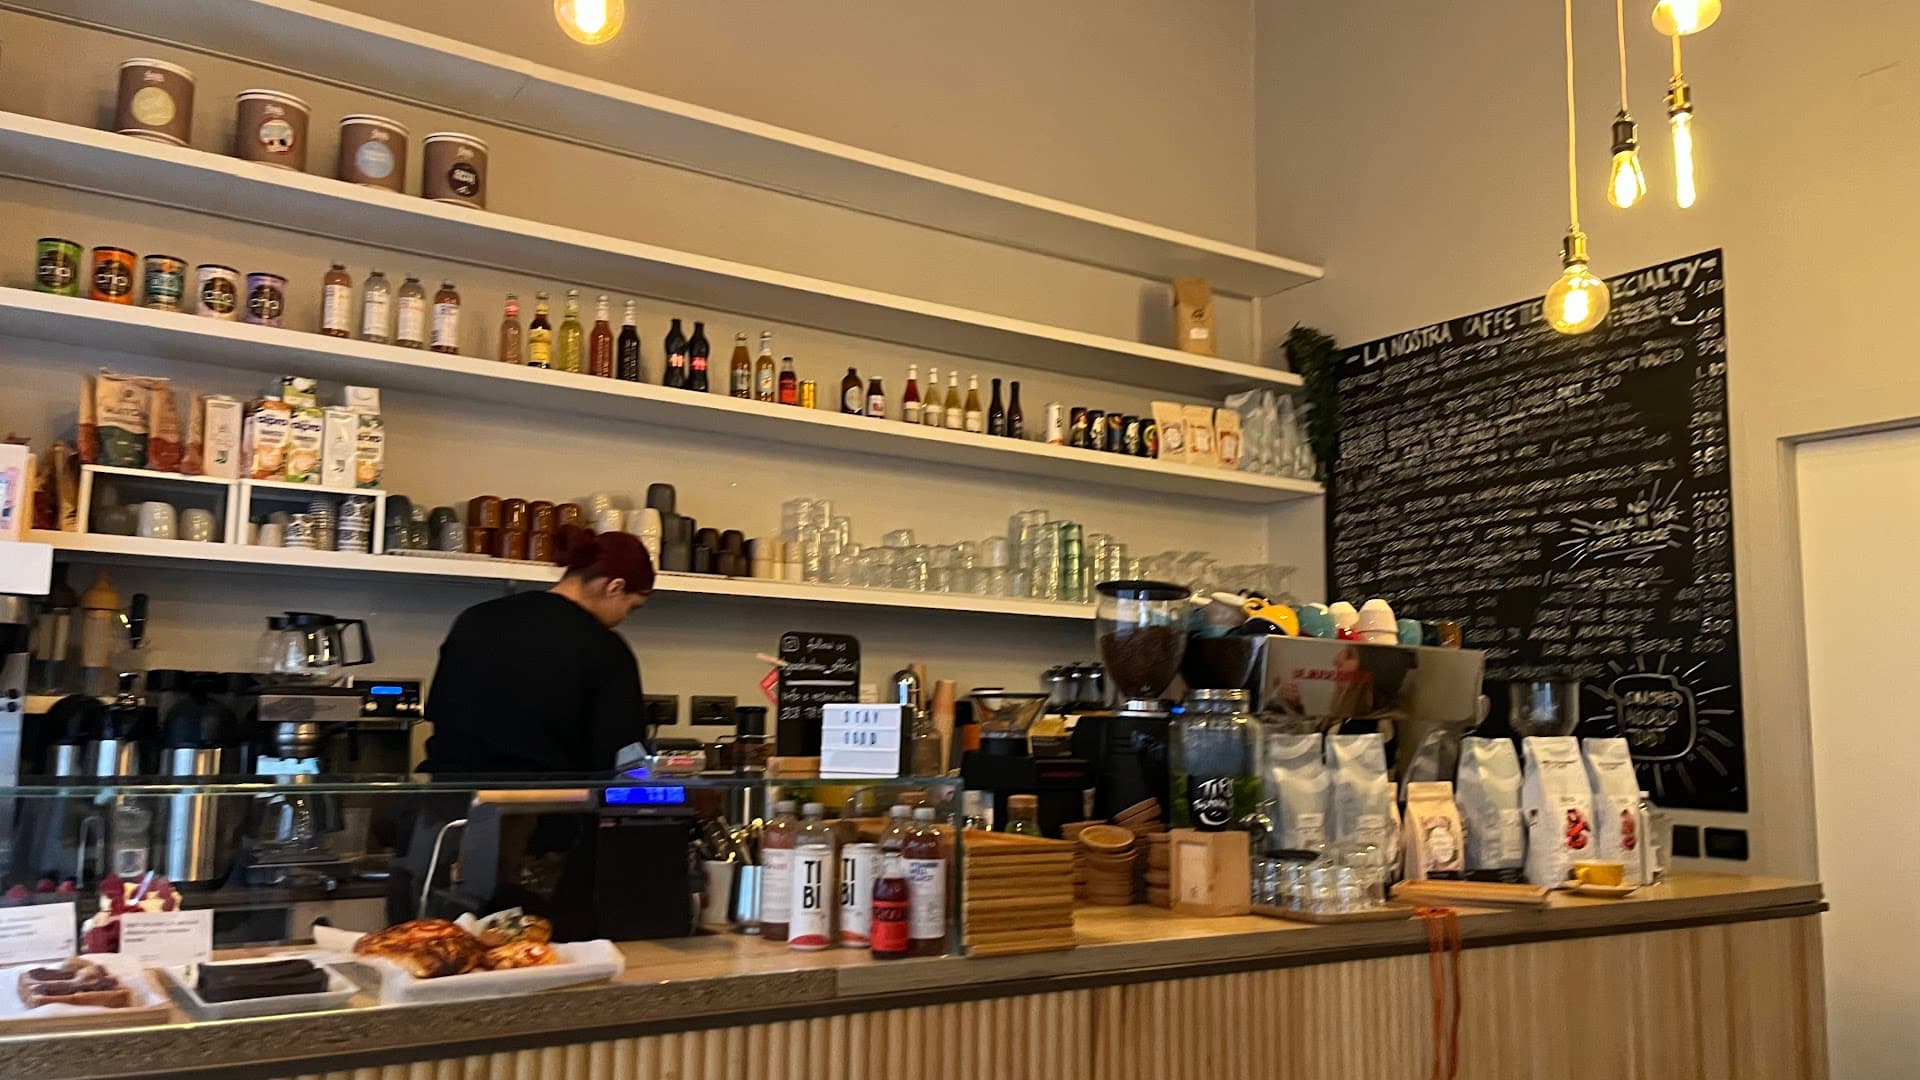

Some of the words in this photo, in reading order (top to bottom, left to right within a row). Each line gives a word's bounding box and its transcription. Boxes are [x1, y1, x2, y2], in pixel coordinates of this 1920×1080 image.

[1364, 342, 1389, 367] LA
[1390, 322, 1453, 357] NOSTRA
[1610, 257, 1702, 299] ECIALTY
[844, 711, 879, 723] STAY
[804, 860, 822, 884] TI
[803, 885, 821, 909] BI
